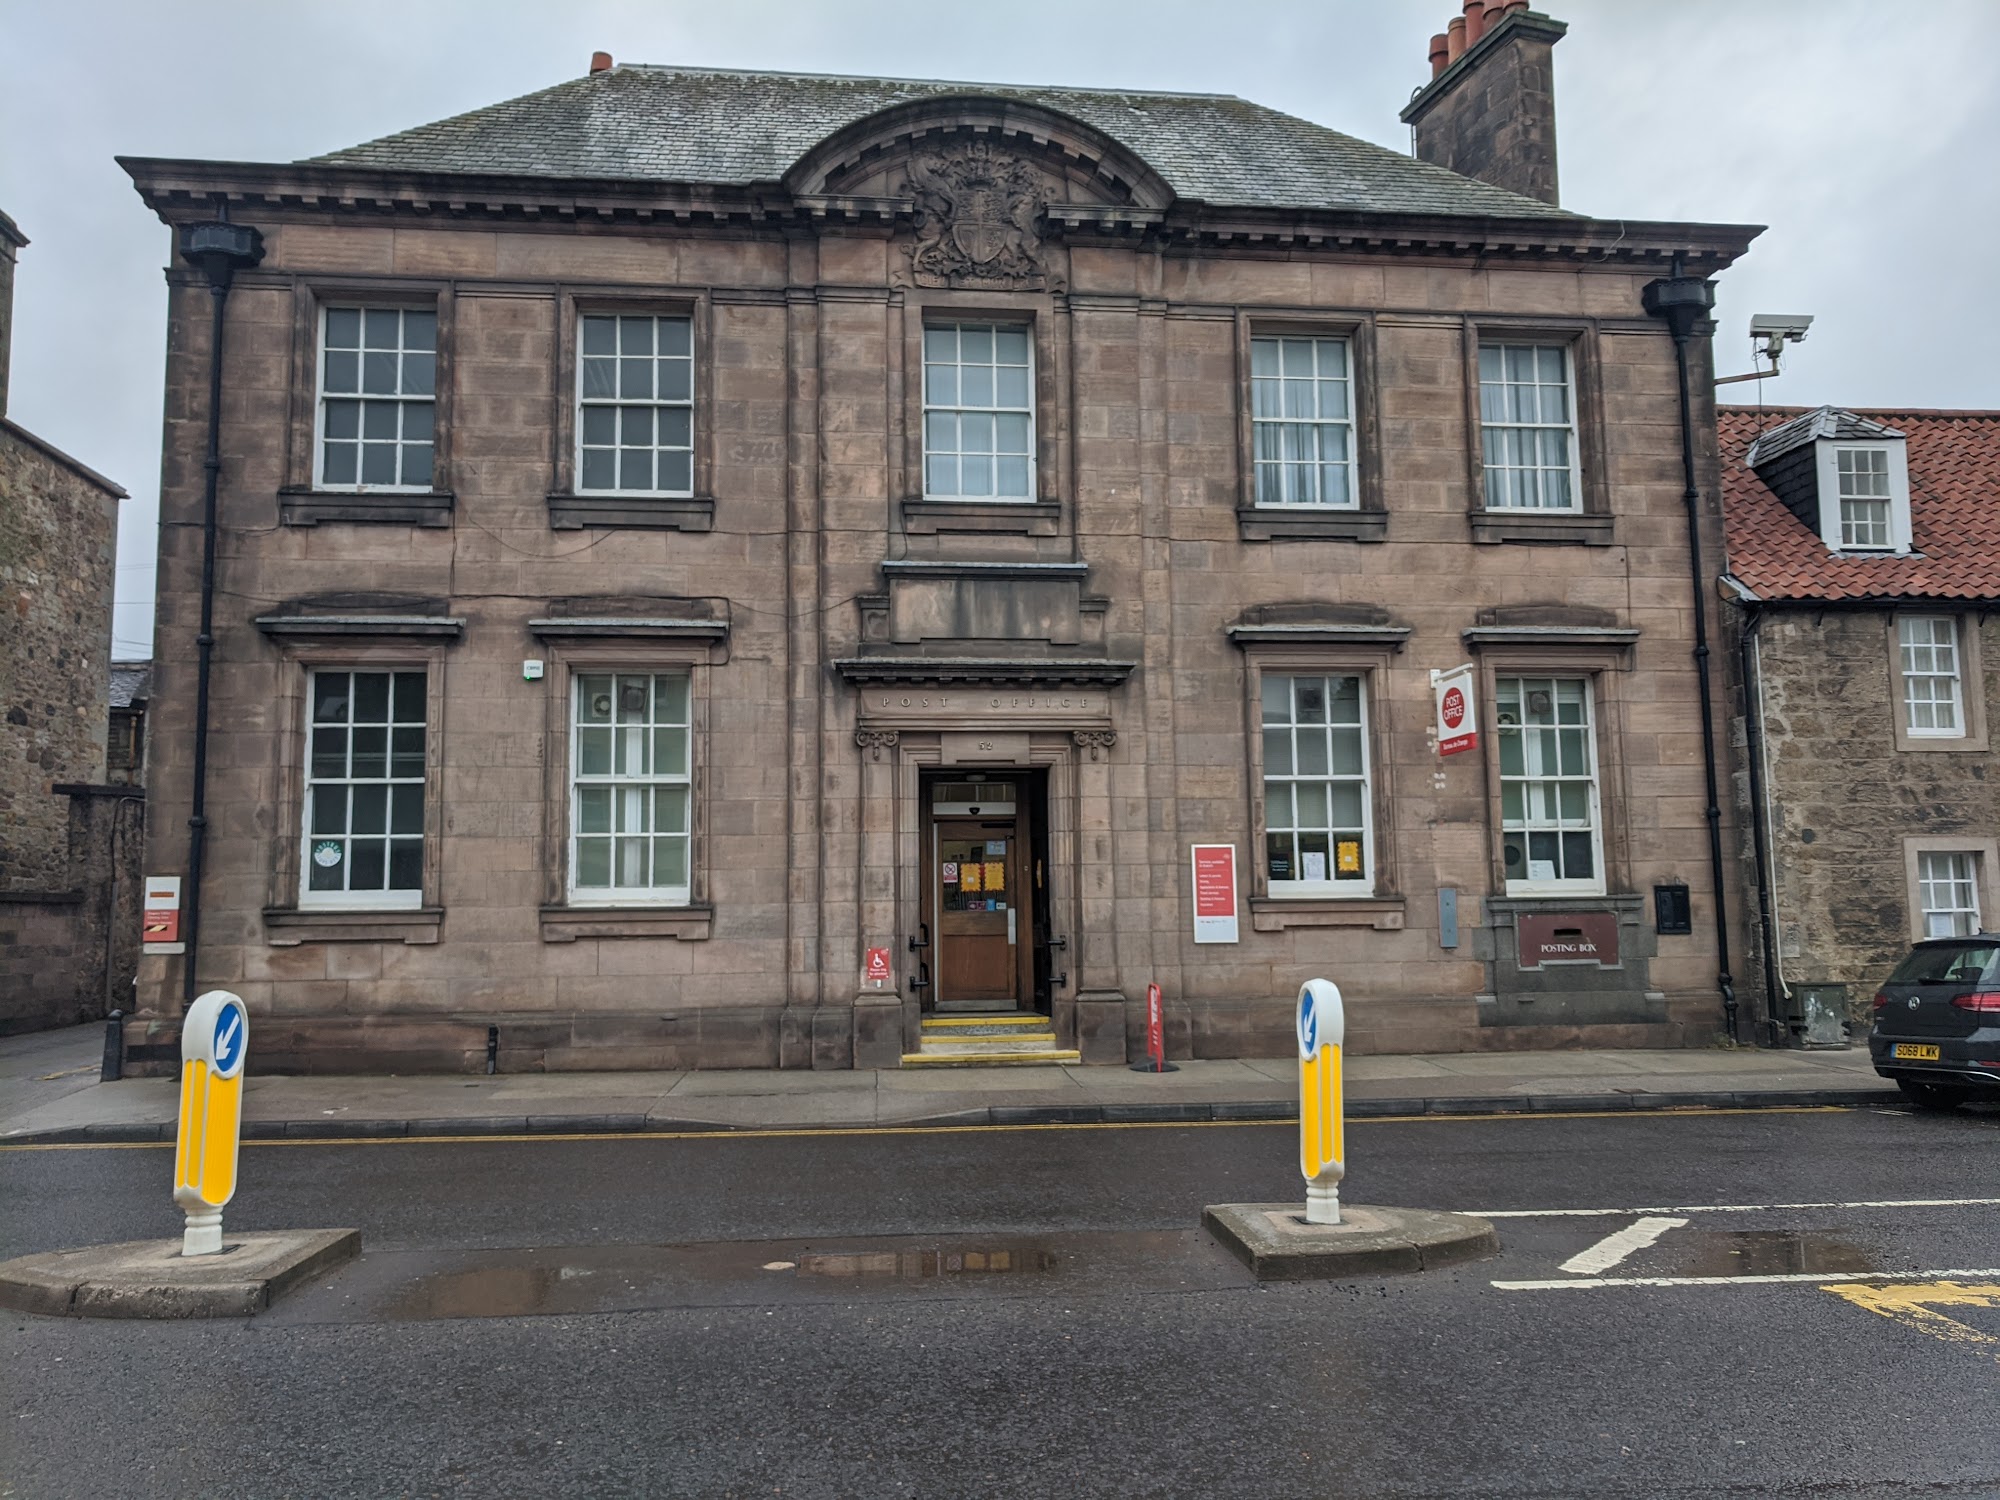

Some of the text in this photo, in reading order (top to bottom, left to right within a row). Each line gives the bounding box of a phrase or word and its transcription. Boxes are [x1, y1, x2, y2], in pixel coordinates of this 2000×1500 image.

[883, 698, 1087, 708] POST OFFICE
[1445, 694, 1460, 708] POST
[1444, 705, 1463, 720] OFFICE
[979, 741, 993, 750] 52
[1541, 943, 1597, 953] POSTING BOX
[1920, 1046, 1937, 1058] LWK
